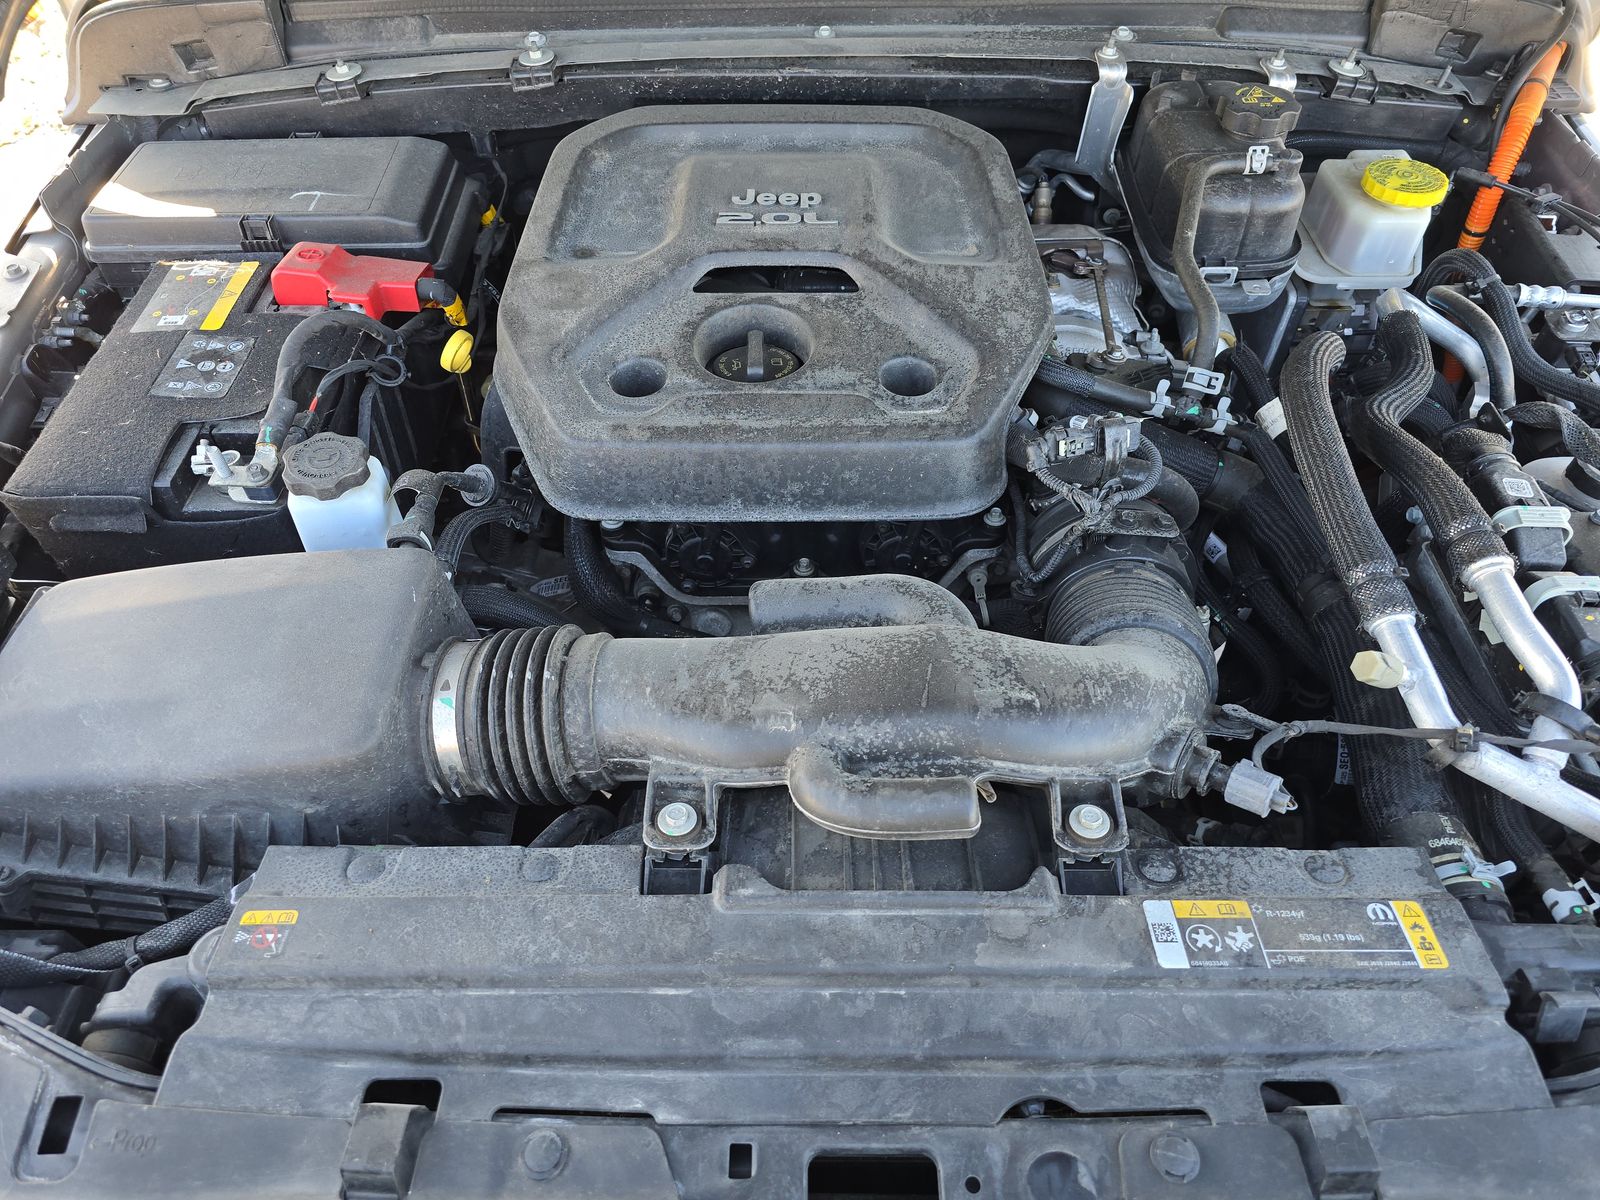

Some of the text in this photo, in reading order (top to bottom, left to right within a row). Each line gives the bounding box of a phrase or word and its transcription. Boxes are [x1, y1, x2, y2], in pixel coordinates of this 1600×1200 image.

[731, 188, 822, 208] Jeep
[715, 212, 839, 227] 2.0L
[1265, 909, 1305, 919] R-1234yf
[1322, 932, 1345, 943] (1.19
[1346, 932, 1364, 943] lbs)
